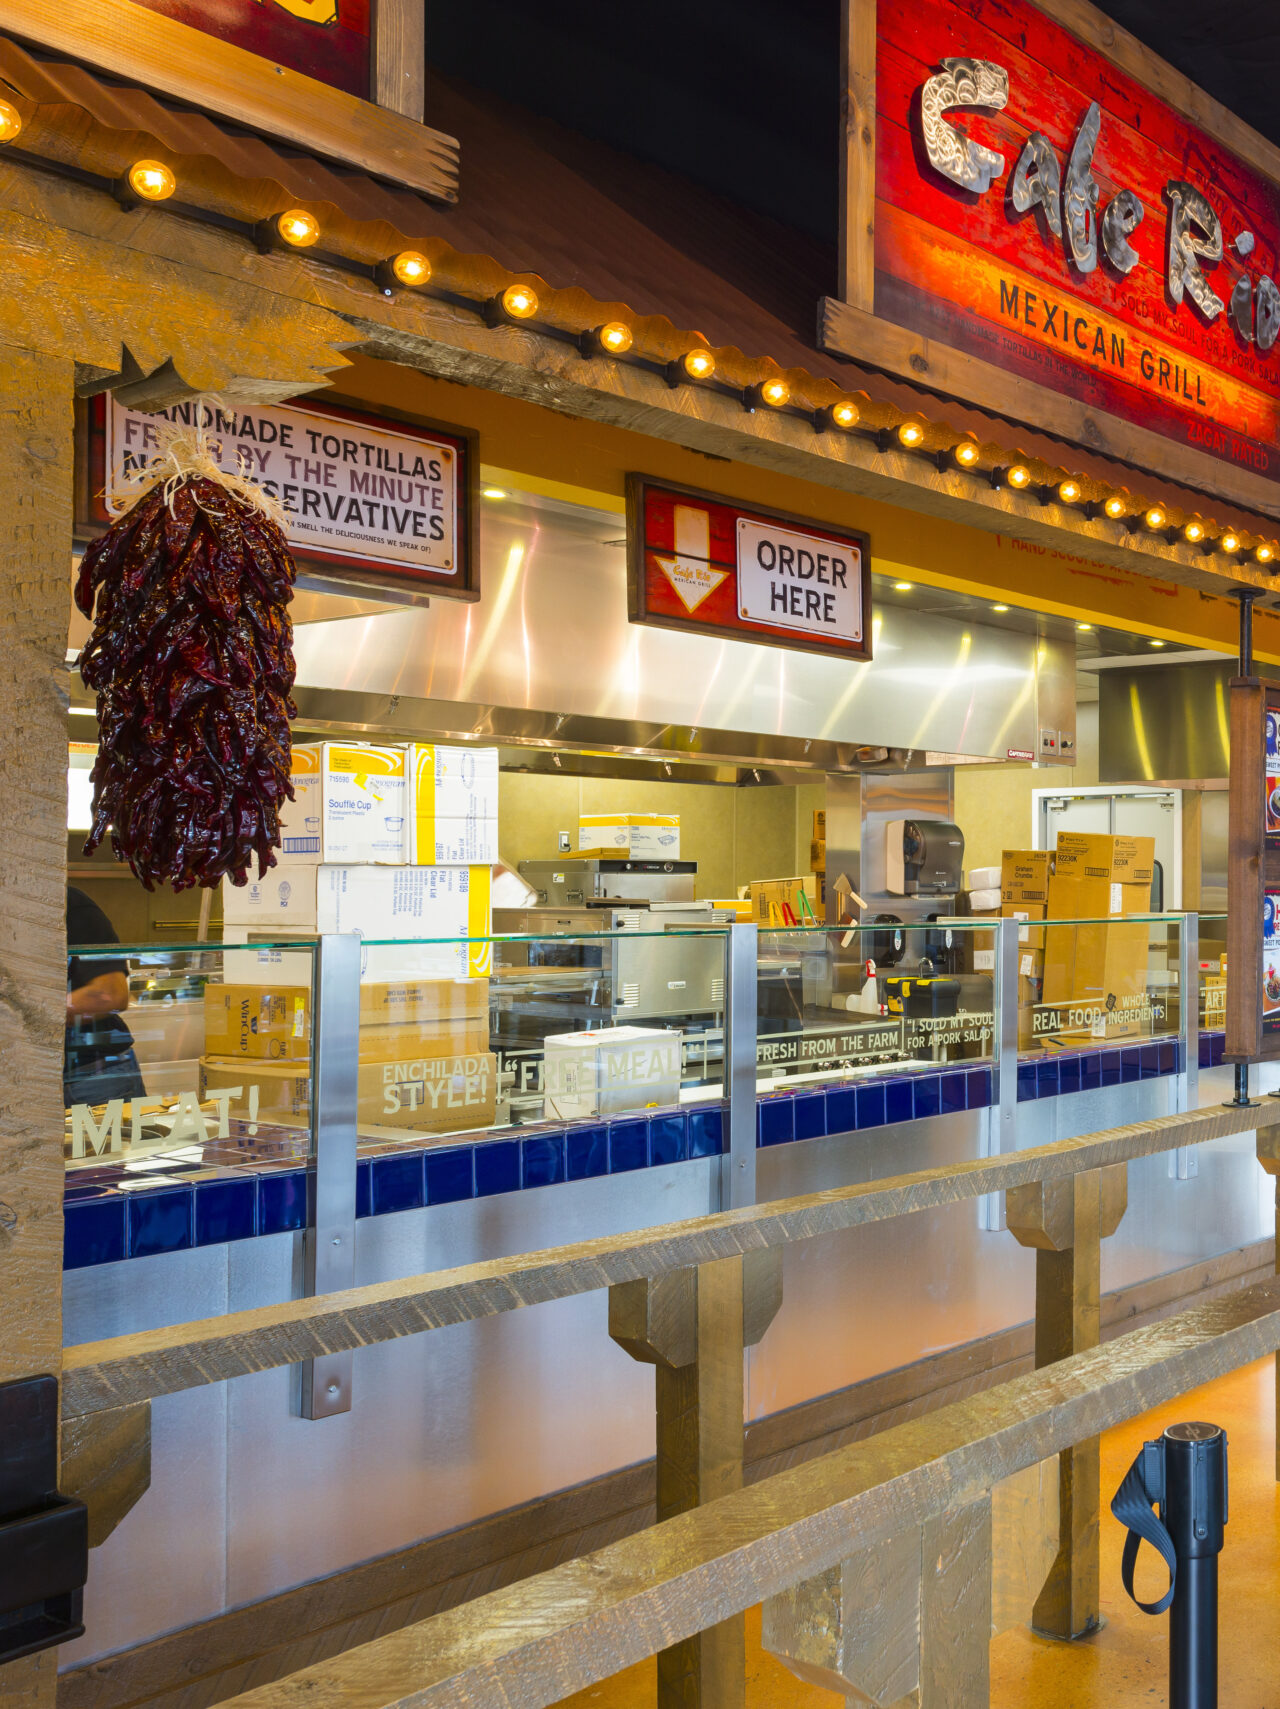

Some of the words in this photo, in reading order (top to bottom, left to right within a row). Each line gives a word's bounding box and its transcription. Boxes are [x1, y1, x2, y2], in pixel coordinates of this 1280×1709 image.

[1000, 280, 1125, 369] MEXICAN
[1141, 350, 1206, 406] GRILL
[1121, 292, 1149, 318] SOLD
[1154, 310, 1168, 327] MY
[1172, 319, 1198, 344] SOUL
[1201, 334, 1219, 354] FOR
[1232, 350, 1256, 374] PORK
[1055, 359, 1068, 375] THE
[305, 429, 443, 483] TORTILLAS
[1187, 419, 1227, 454] ZAGAT
[1232, 439, 1269, 470] RATED
[236, 444, 272, 473] BY
[285, 453, 338, 488] THE
[349, 468, 445, 511] MINUTE
[297, 521, 319, 533] SMELL
[320, 524, 334, 536] THE
[335, 528, 385, 545] DELICIOUSNESS
[387, 538, 397, 546] WE
[399, 540, 419, 552] SPEAK
[757, 540, 848, 589] ORDER
[770, 582, 837, 623] HERE
[357, 800, 371, 811] Cup
[1108, 1004, 1165, 1025] INGREDIENTS
[1122, 992, 1150, 1007] WHOLE
[239, 999, 250, 1051] WinCup
[919, 1018, 946, 1032] SOLD
[950, 1016, 965, 1029] MY
[969, 1013, 994, 1026] SOUL
[1033, 1012, 1064, 1032] REAL
[1068, 1007, 1101, 1027] FOOD
[756, 1042, 797, 1061] FRESH
[801, 1038, 837, 1056] FROM
[841, 1035, 864, 1051] THE
[868, 1031, 898, 1048] FARM
[907, 1036, 925, 1049] FOR
[937, 1031, 961, 1045] PORK
[383, 1058, 490, 1083] ENCHILADA
[383, 1074, 488, 1114] STYLE!
[71, 1085, 259, 1158] MEAT!
